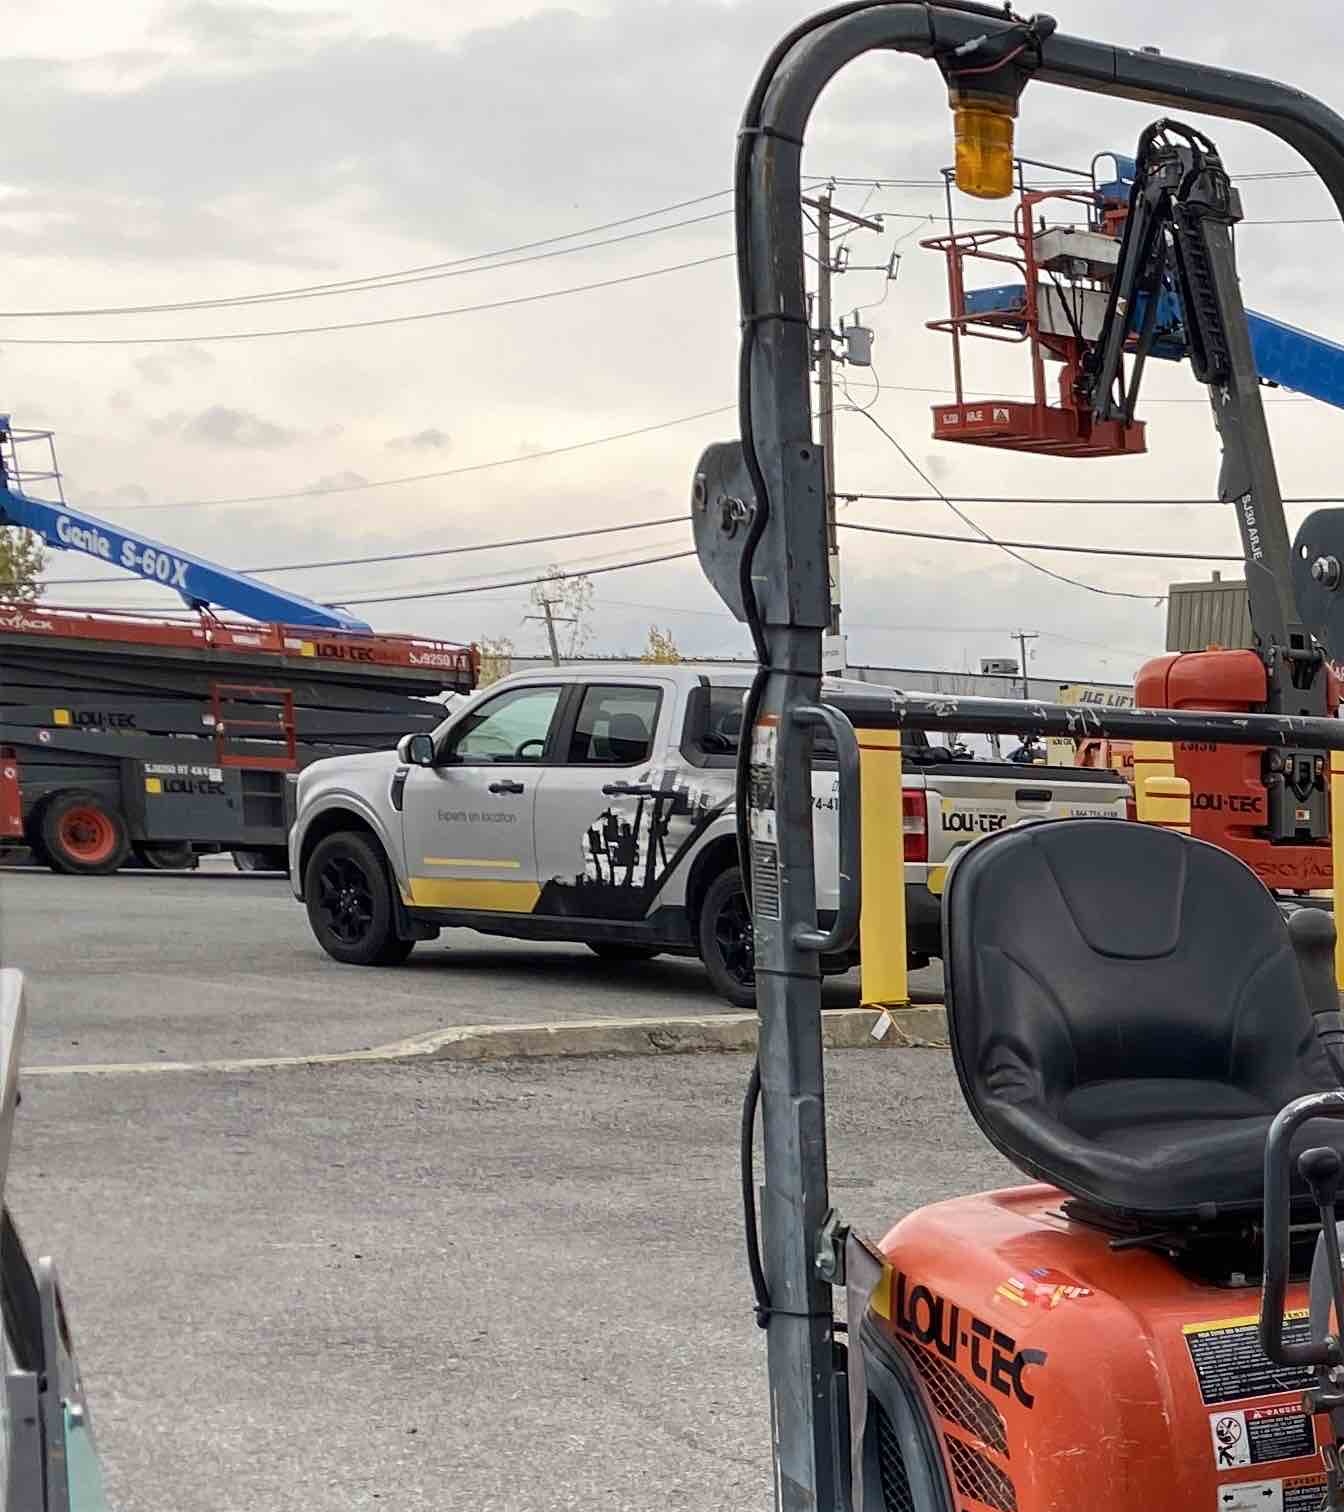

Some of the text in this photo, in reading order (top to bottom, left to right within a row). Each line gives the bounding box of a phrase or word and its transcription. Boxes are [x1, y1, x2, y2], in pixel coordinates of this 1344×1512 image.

[56, 515, 188, 588] Genie S-60X
[315, 643, 375, 661] LOU-TEC
[1079, 690, 1103, 703] JLG
[71, 711, 136, 728] LOU-TEC
[1190, 793, 1264, 813] LOU-TEC
[941, 811, 1008, 833] LOU-TEC
[895, 1270, 1048, 1410] LOU-TEC
